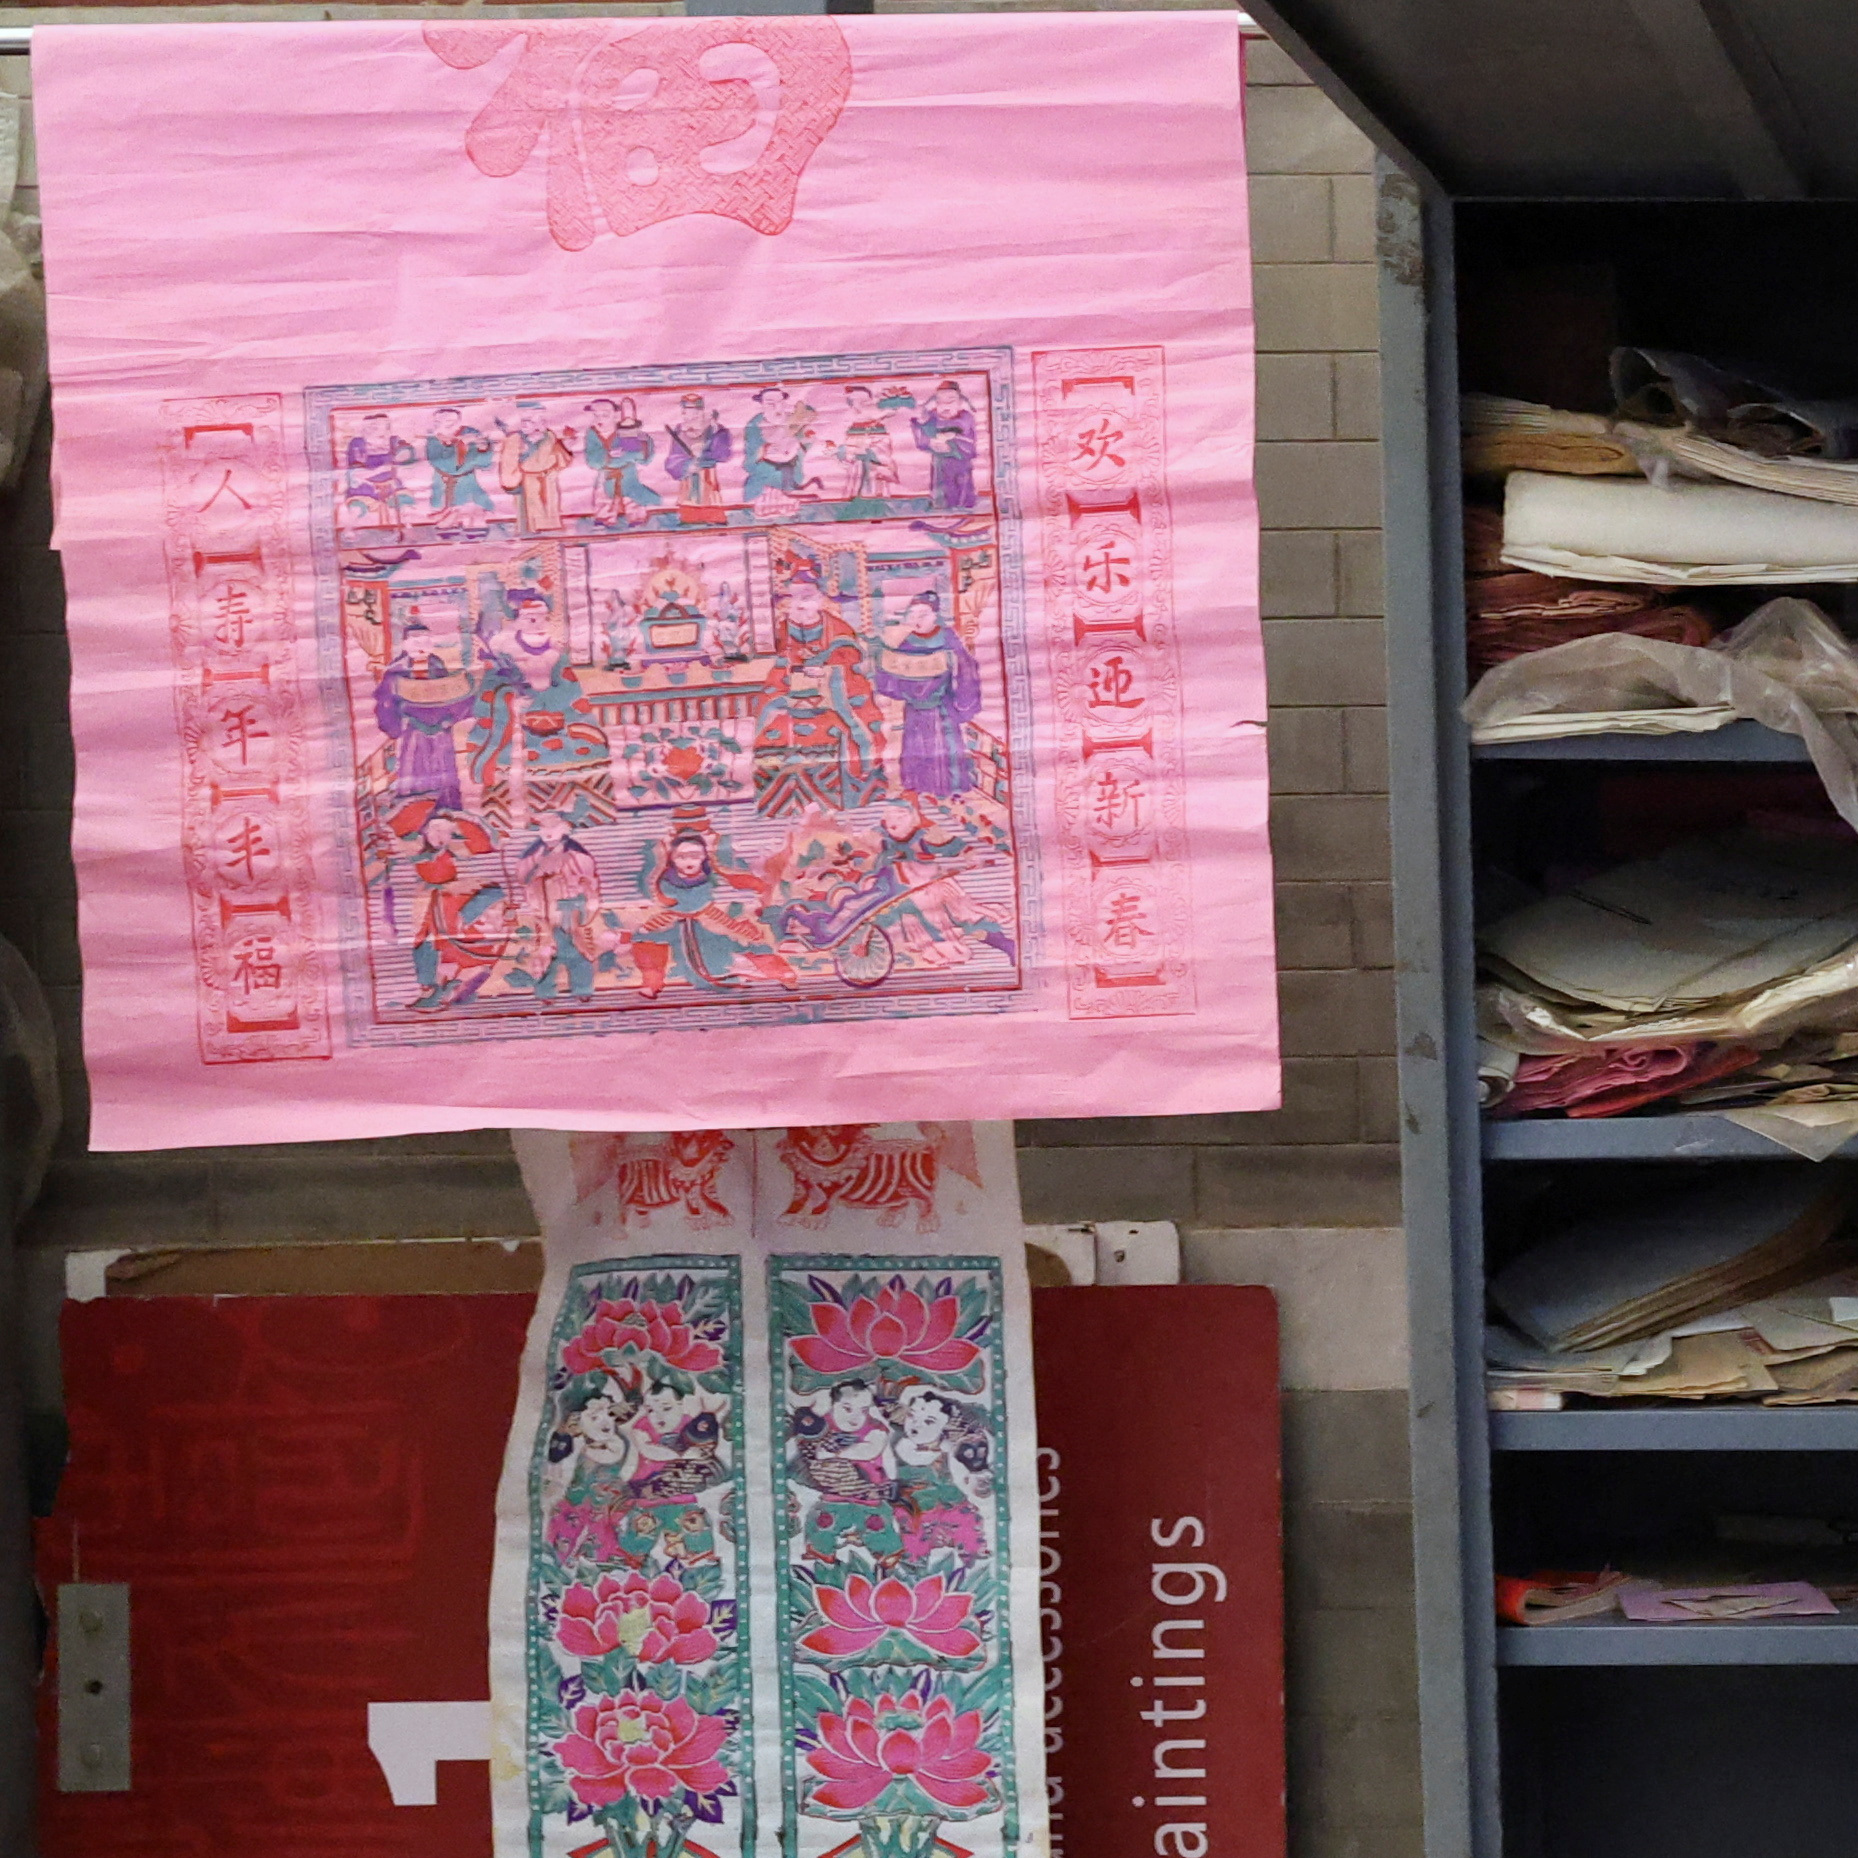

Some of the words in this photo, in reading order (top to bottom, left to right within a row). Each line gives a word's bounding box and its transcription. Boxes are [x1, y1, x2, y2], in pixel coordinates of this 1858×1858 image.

[1072, 417, 1160, 954] 欢乐迎新春
